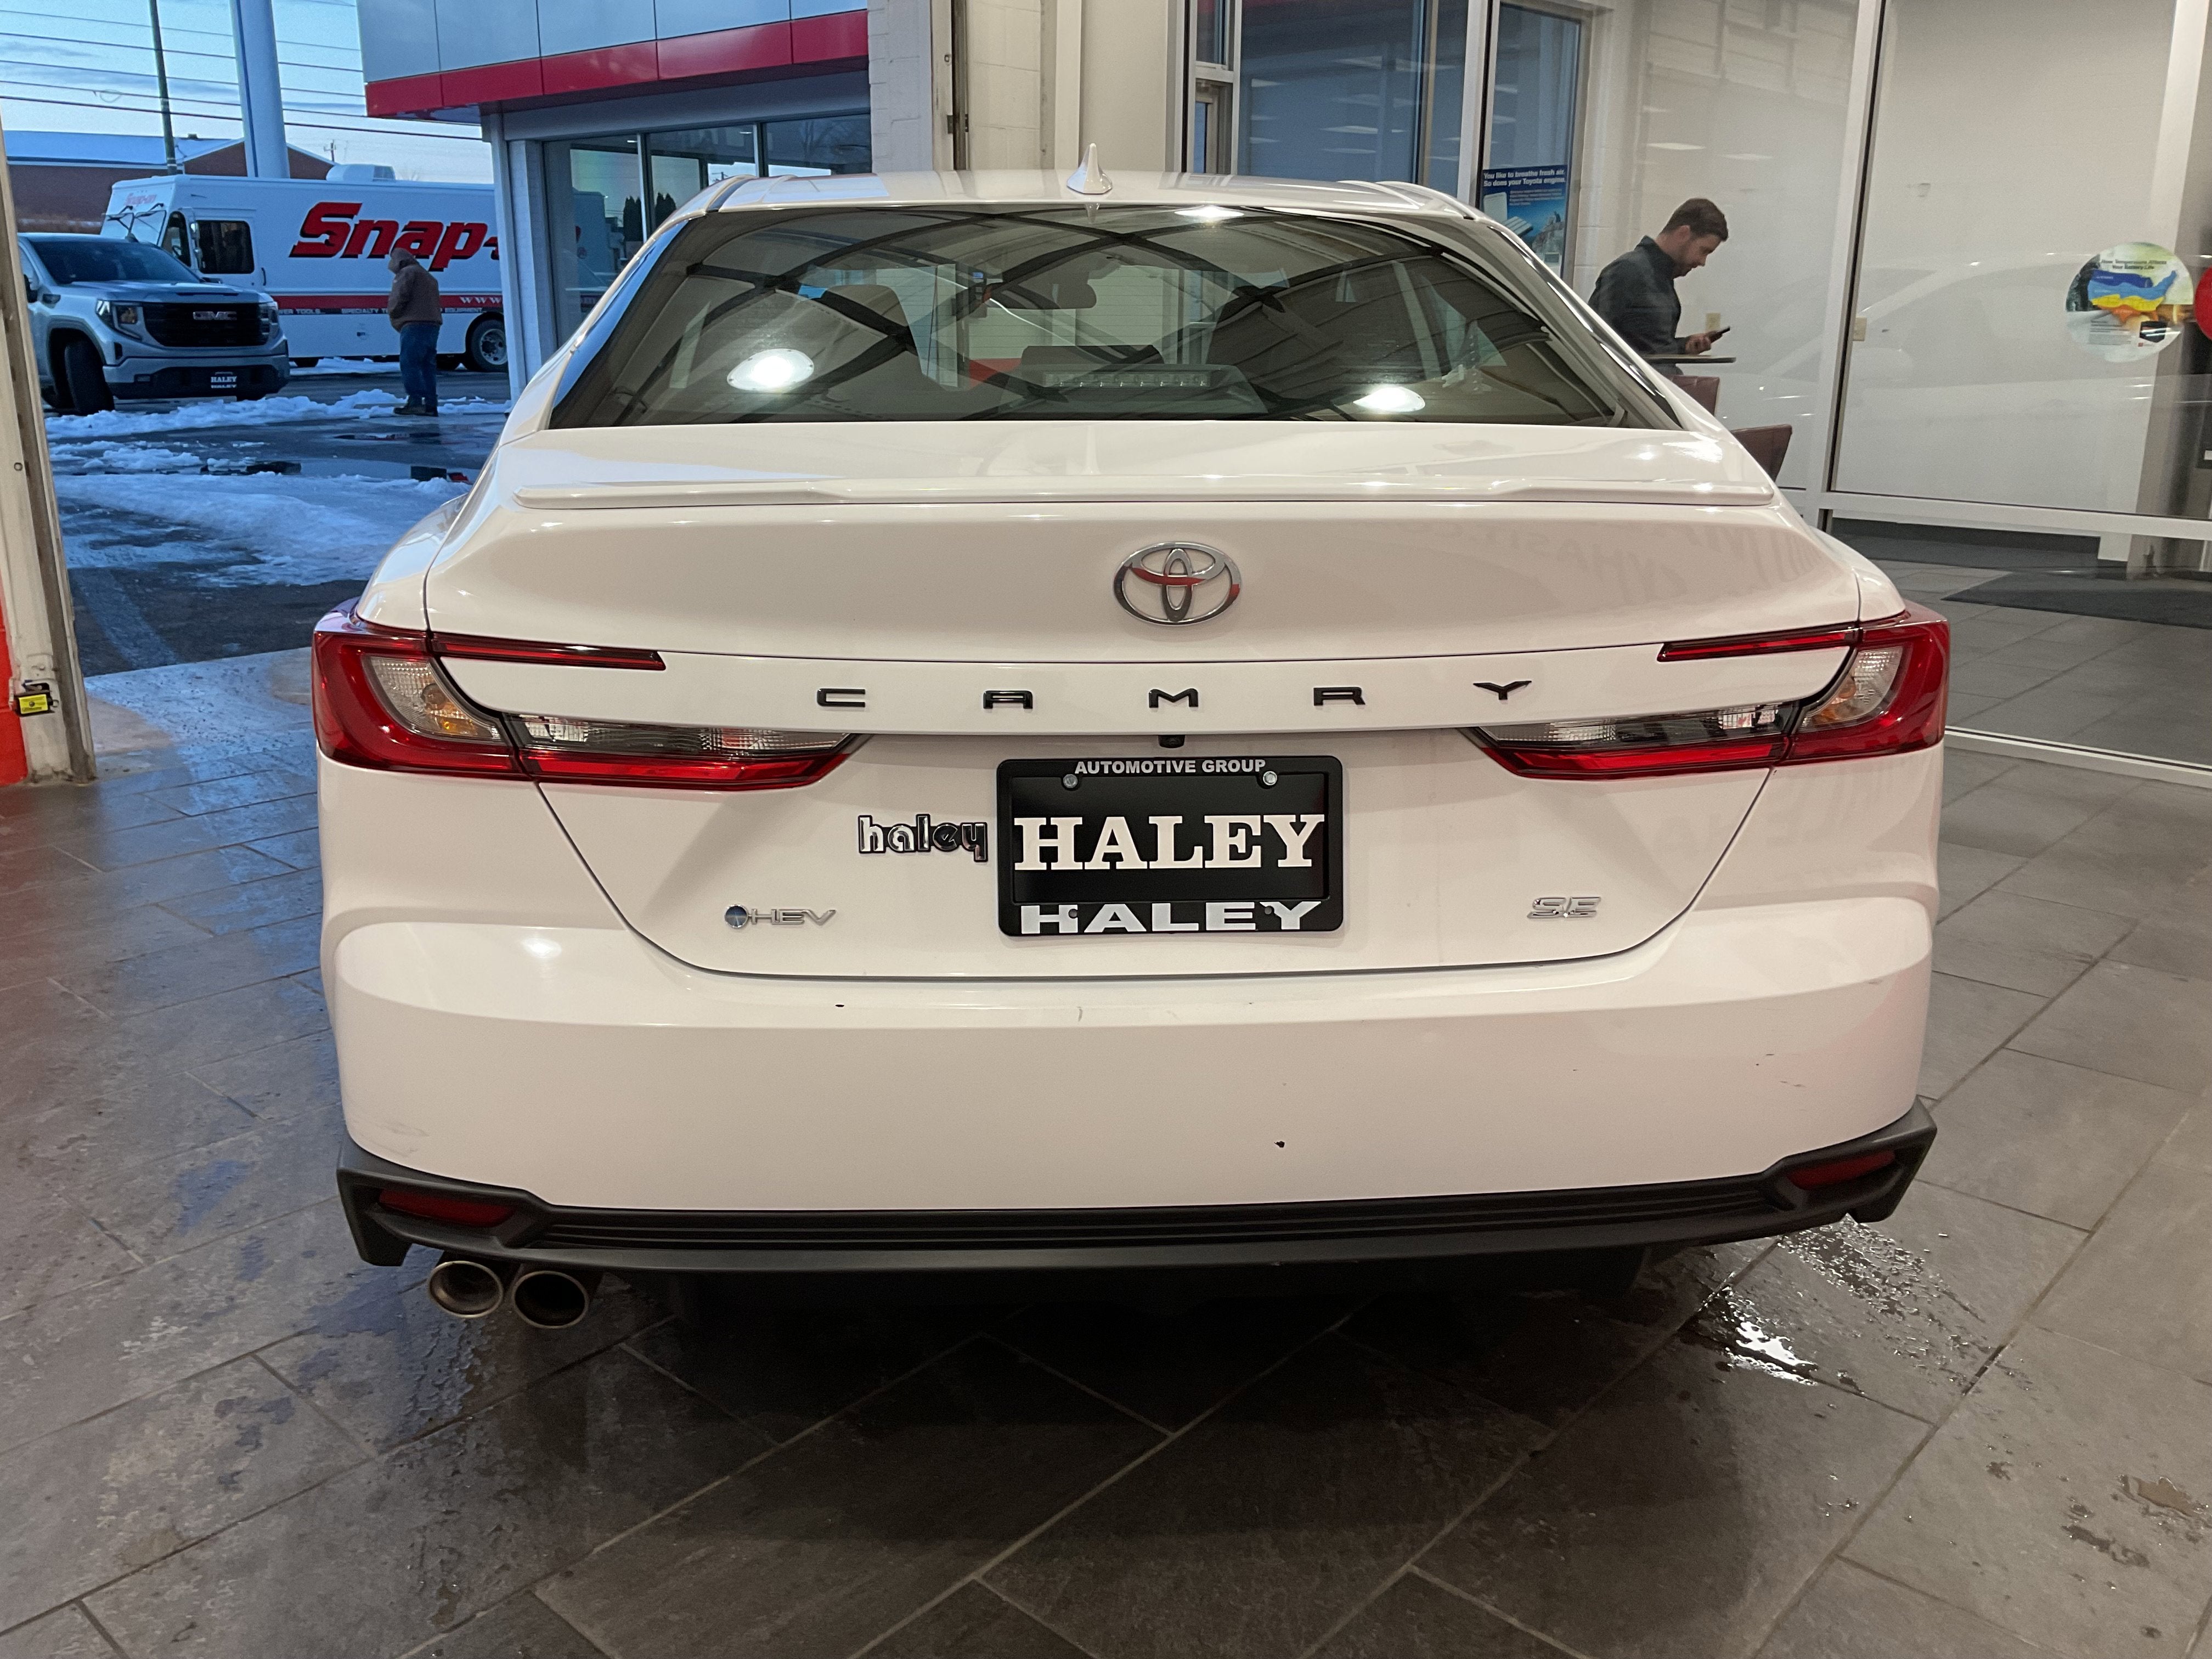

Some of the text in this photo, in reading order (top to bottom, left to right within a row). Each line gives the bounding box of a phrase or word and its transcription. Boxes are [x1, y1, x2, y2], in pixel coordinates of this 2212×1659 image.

[289, 202, 500, 272] Snap-
[193, 311, 237, 320] GMC
[816, 680, 1533, 709] CAMRY
[1074, 759, 1266, 774] AUTOMOTIVE GROUP
[857, 814, 988, 862] haley
[1013, 814, 1325, 871] HALEY
[751, 908, 837, 926] HEV
[1020, 901, 1322, 934] HALEY
[1527, 896, 1601, 919] SE
